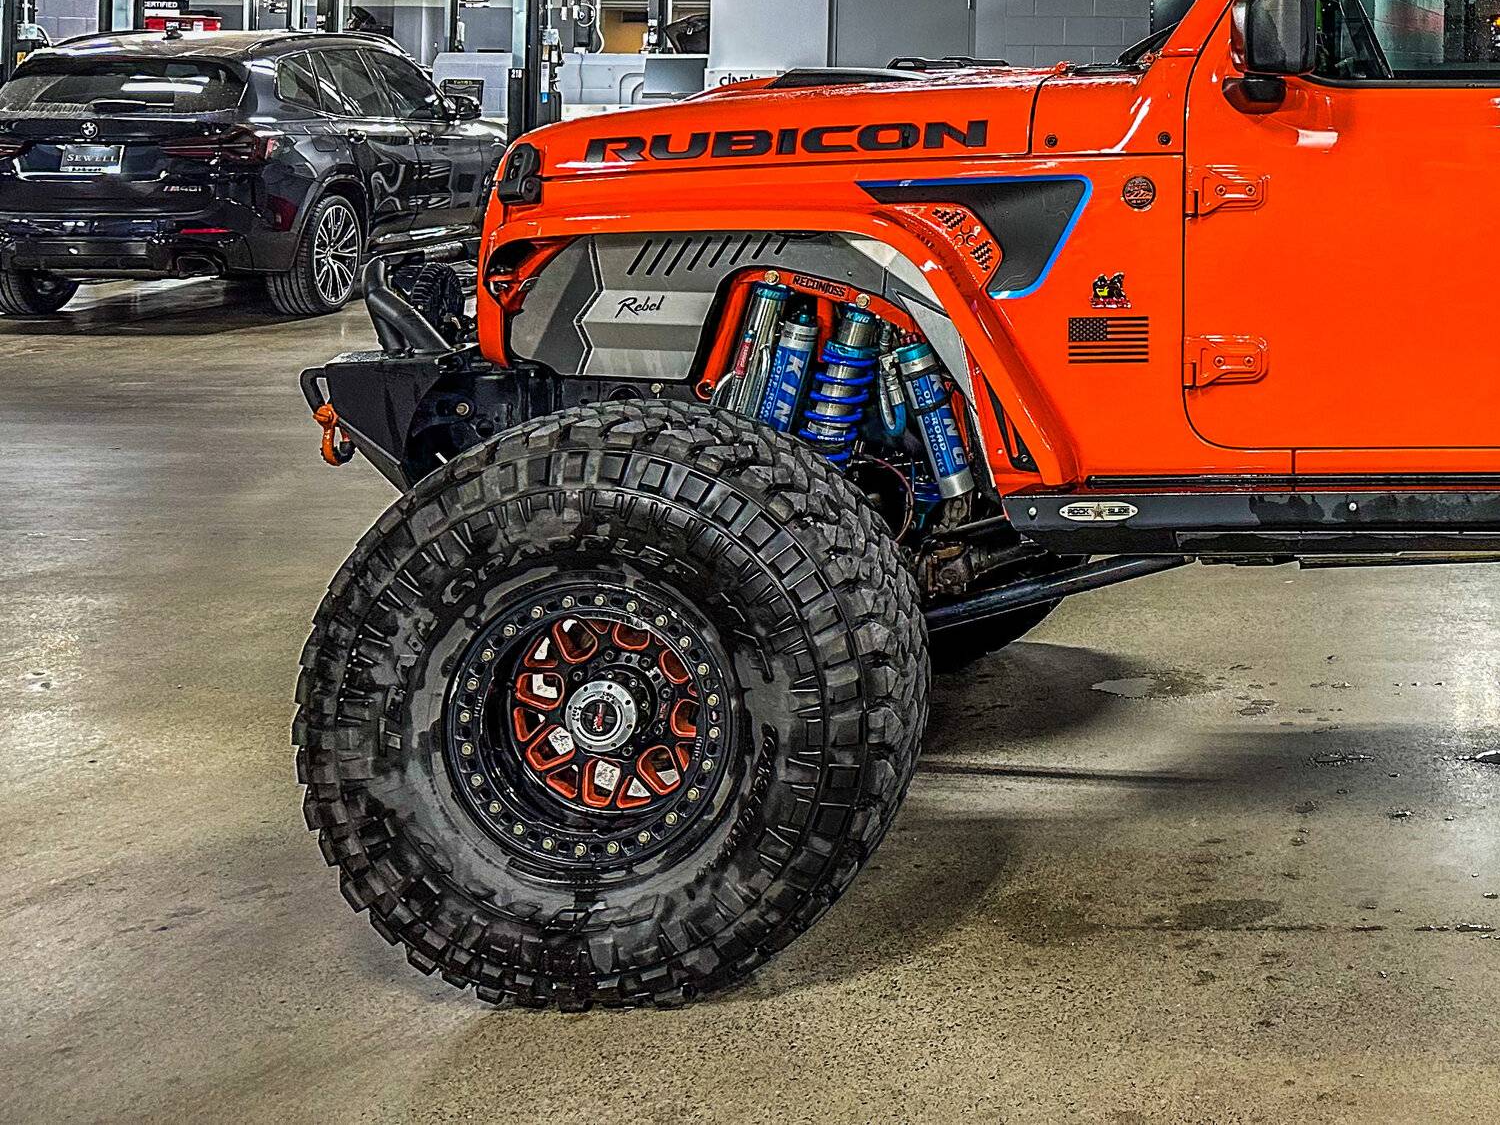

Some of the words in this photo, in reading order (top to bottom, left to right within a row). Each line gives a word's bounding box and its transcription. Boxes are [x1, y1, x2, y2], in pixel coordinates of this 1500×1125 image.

[66, 153, 118, 163] SEWELL
[584, 119, 989, 163] RUBICON
[614, 294, 665, 319] Rebel
[772, 355, 804, 424] KIN
